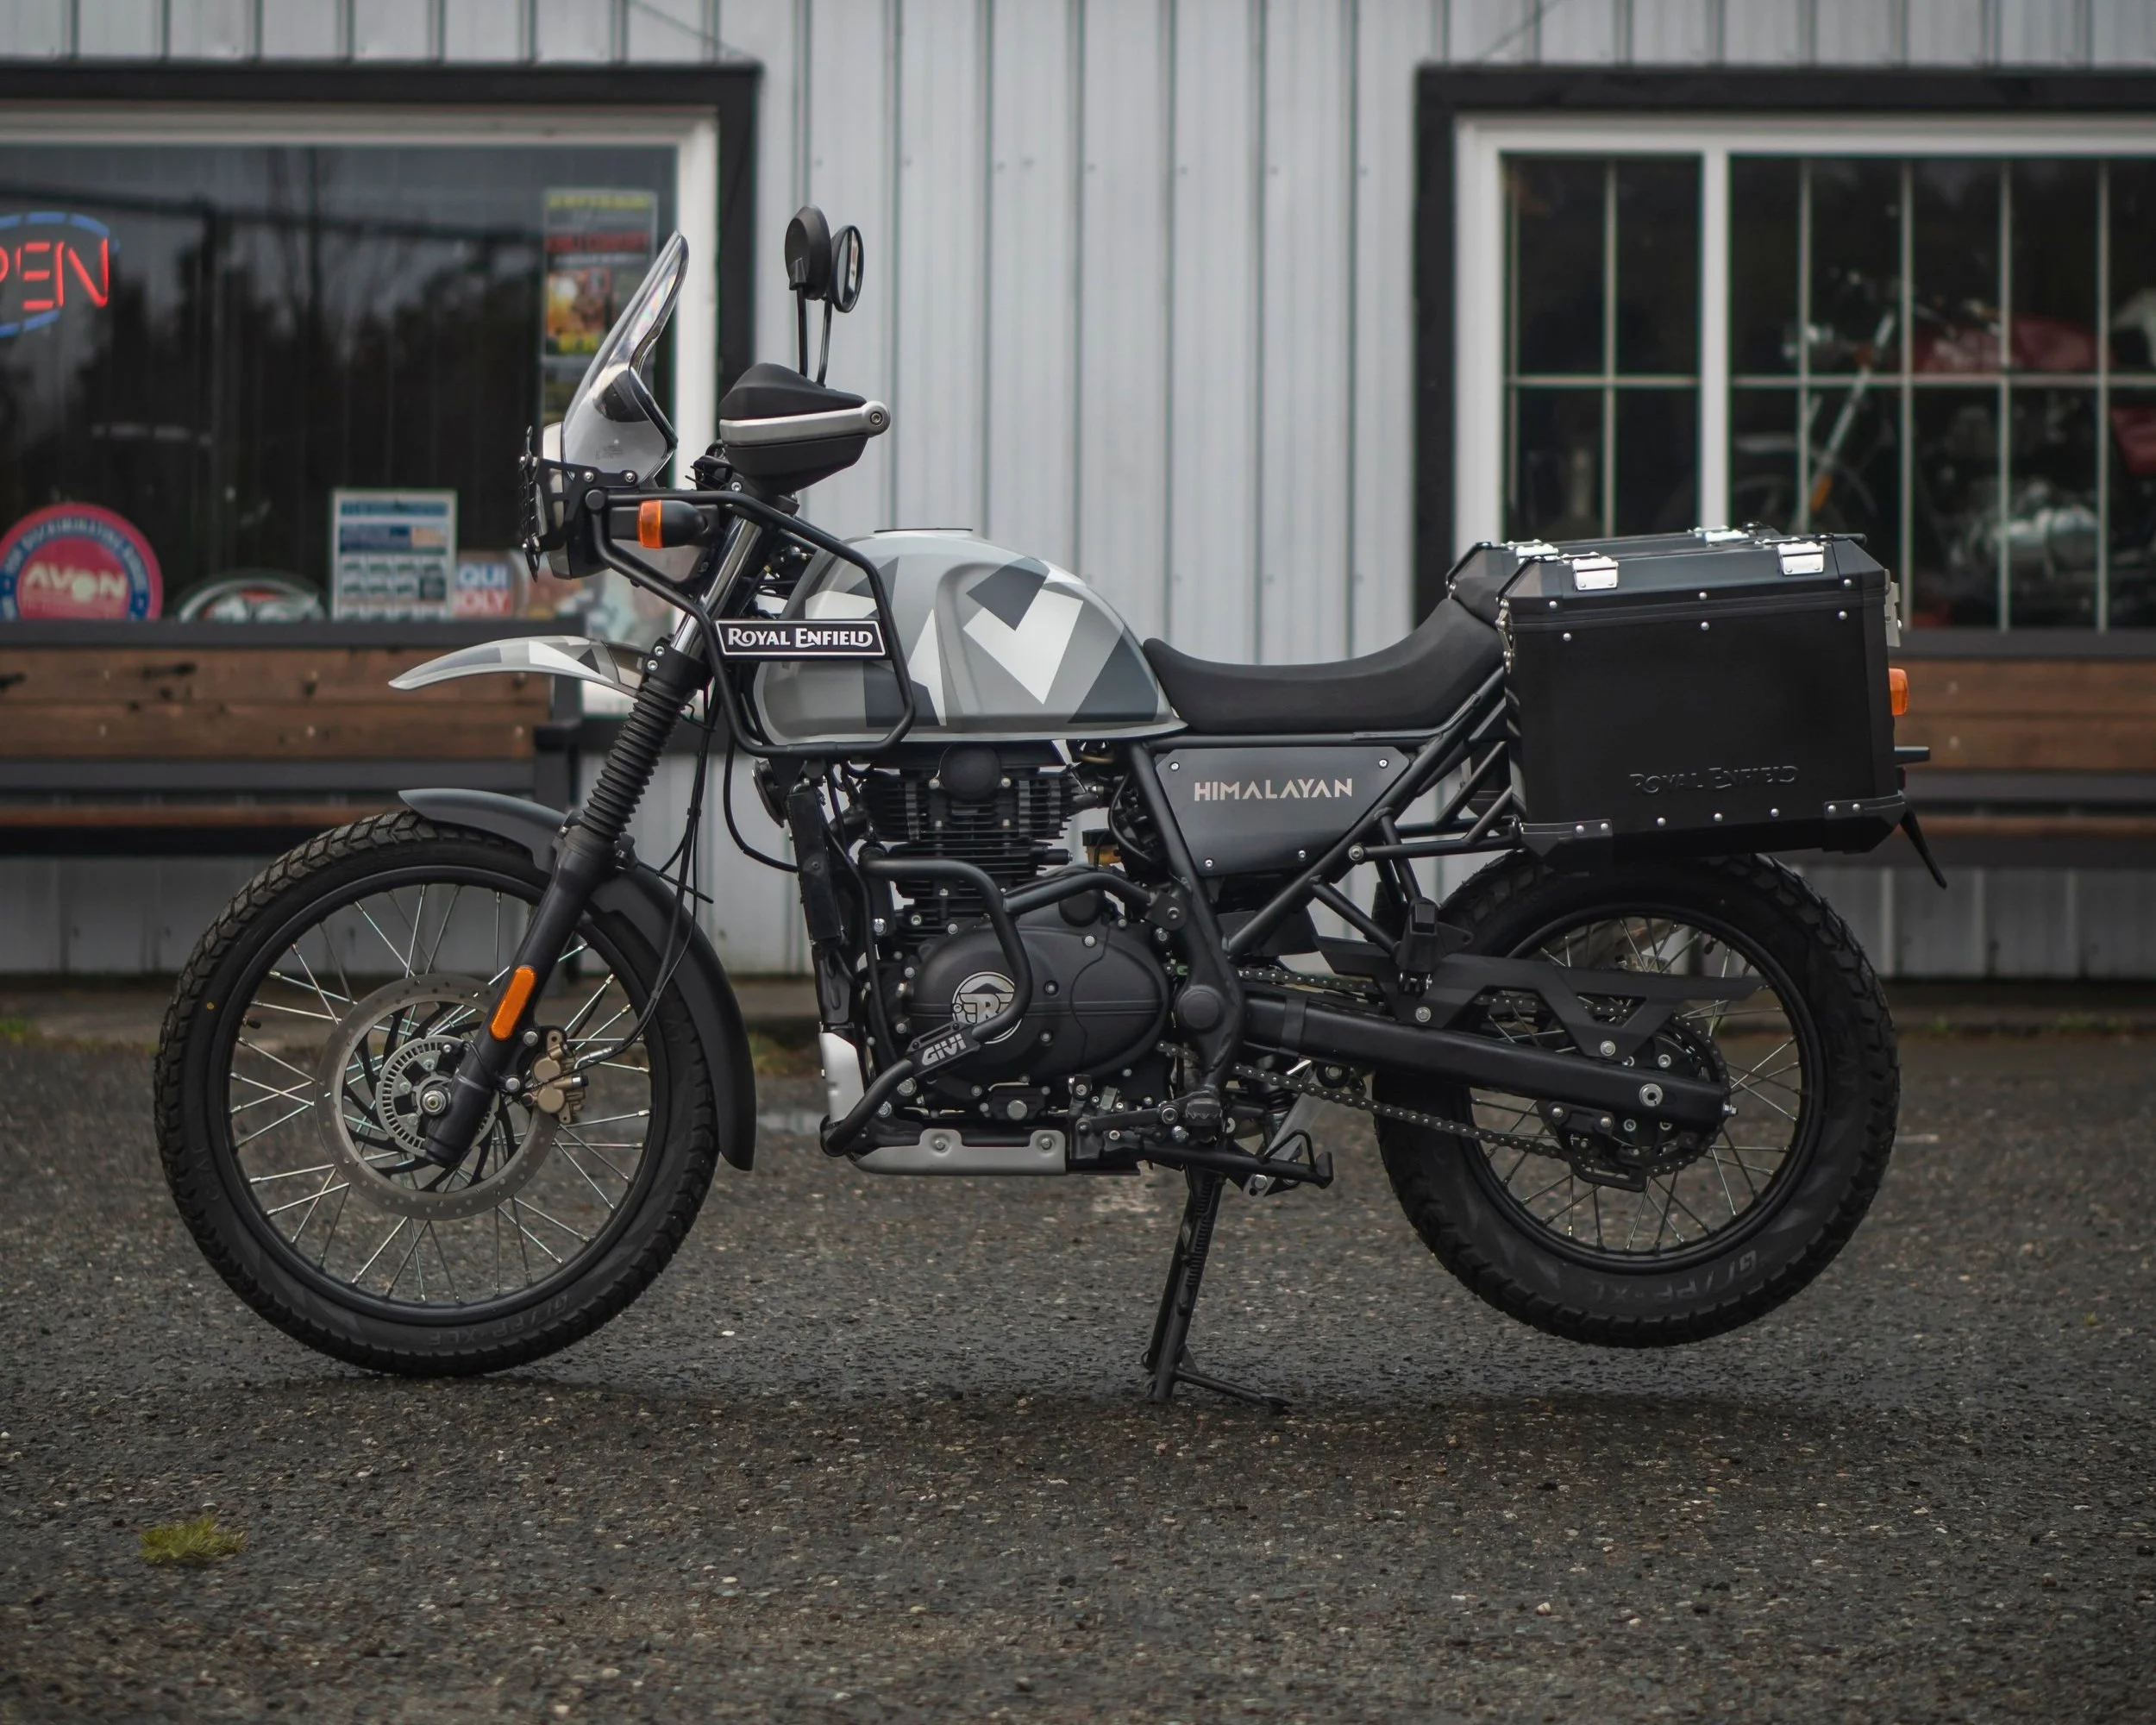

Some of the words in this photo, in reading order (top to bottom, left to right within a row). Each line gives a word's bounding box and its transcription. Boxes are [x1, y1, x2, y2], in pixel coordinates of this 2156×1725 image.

[0, 237, 110, 308] EN
[24, 561, 128, 602] AVON
[459, 565, 508, 590] QUI
[728, 628, 790, 647] ROYAL
[795, 628, 873, 648] ENFIELD
[1194, 778, 1352, 801] HIMALAYAN
[922, 1033, 967, 1066] GIVI
